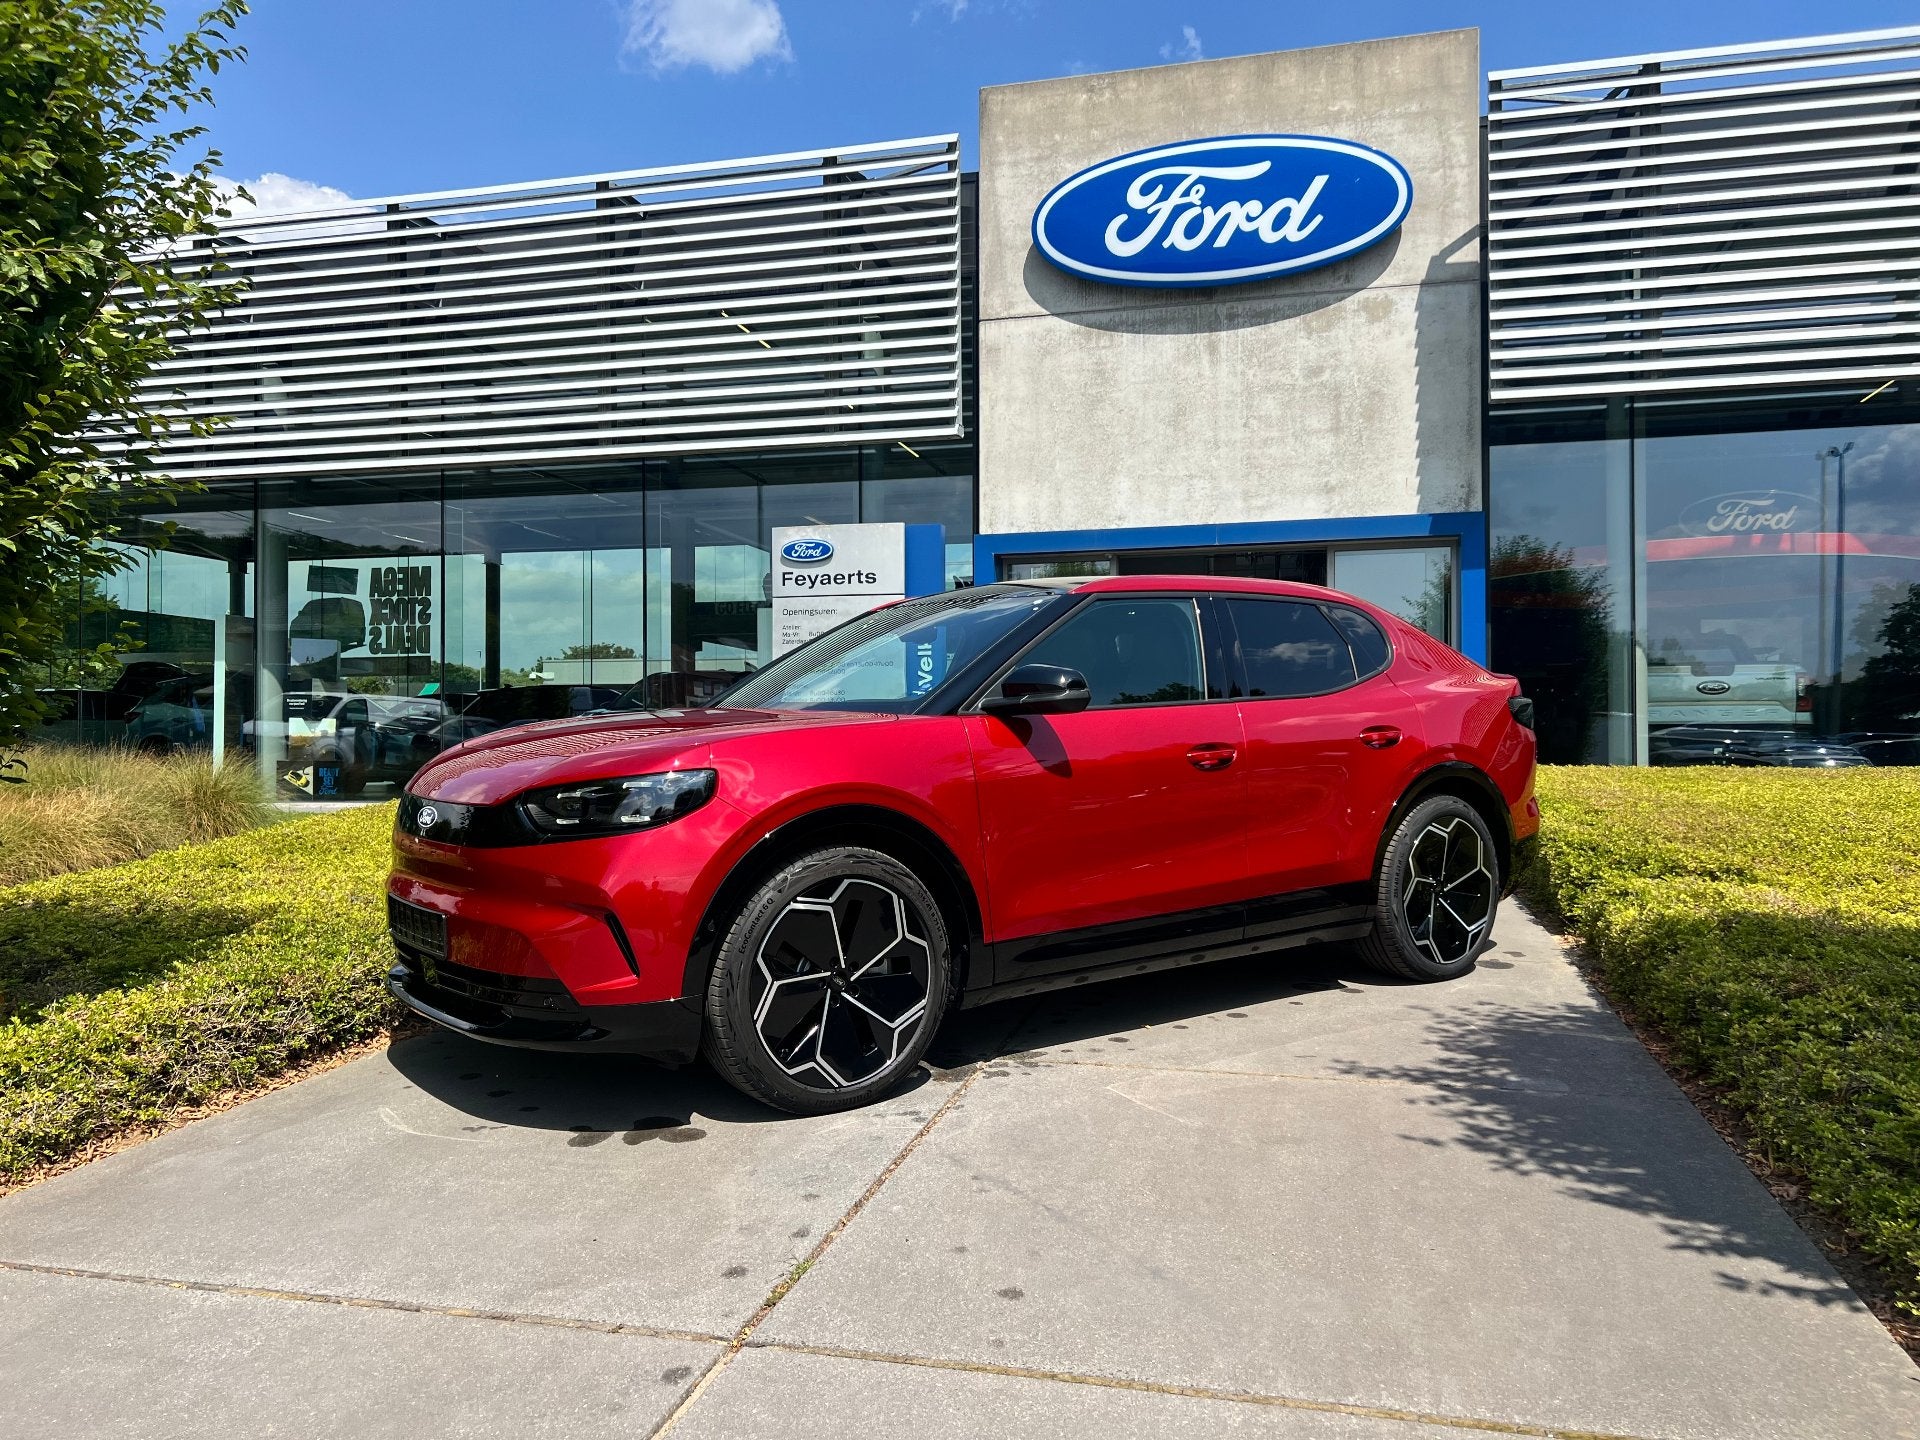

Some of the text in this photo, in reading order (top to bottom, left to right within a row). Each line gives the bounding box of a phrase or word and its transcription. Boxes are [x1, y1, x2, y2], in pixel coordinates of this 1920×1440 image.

[1104, 160, 1330, 257] Ford
[1706, 498, 1799, 532] Ford
[791, 542, 822, 557] Ford
[782, 570, 877, 589] Feyaerts
[782, 608, 838, 617] Openingsuren:
[739, 909, 764, 954] EcoContact
[762, 903, 769, 911] 6
